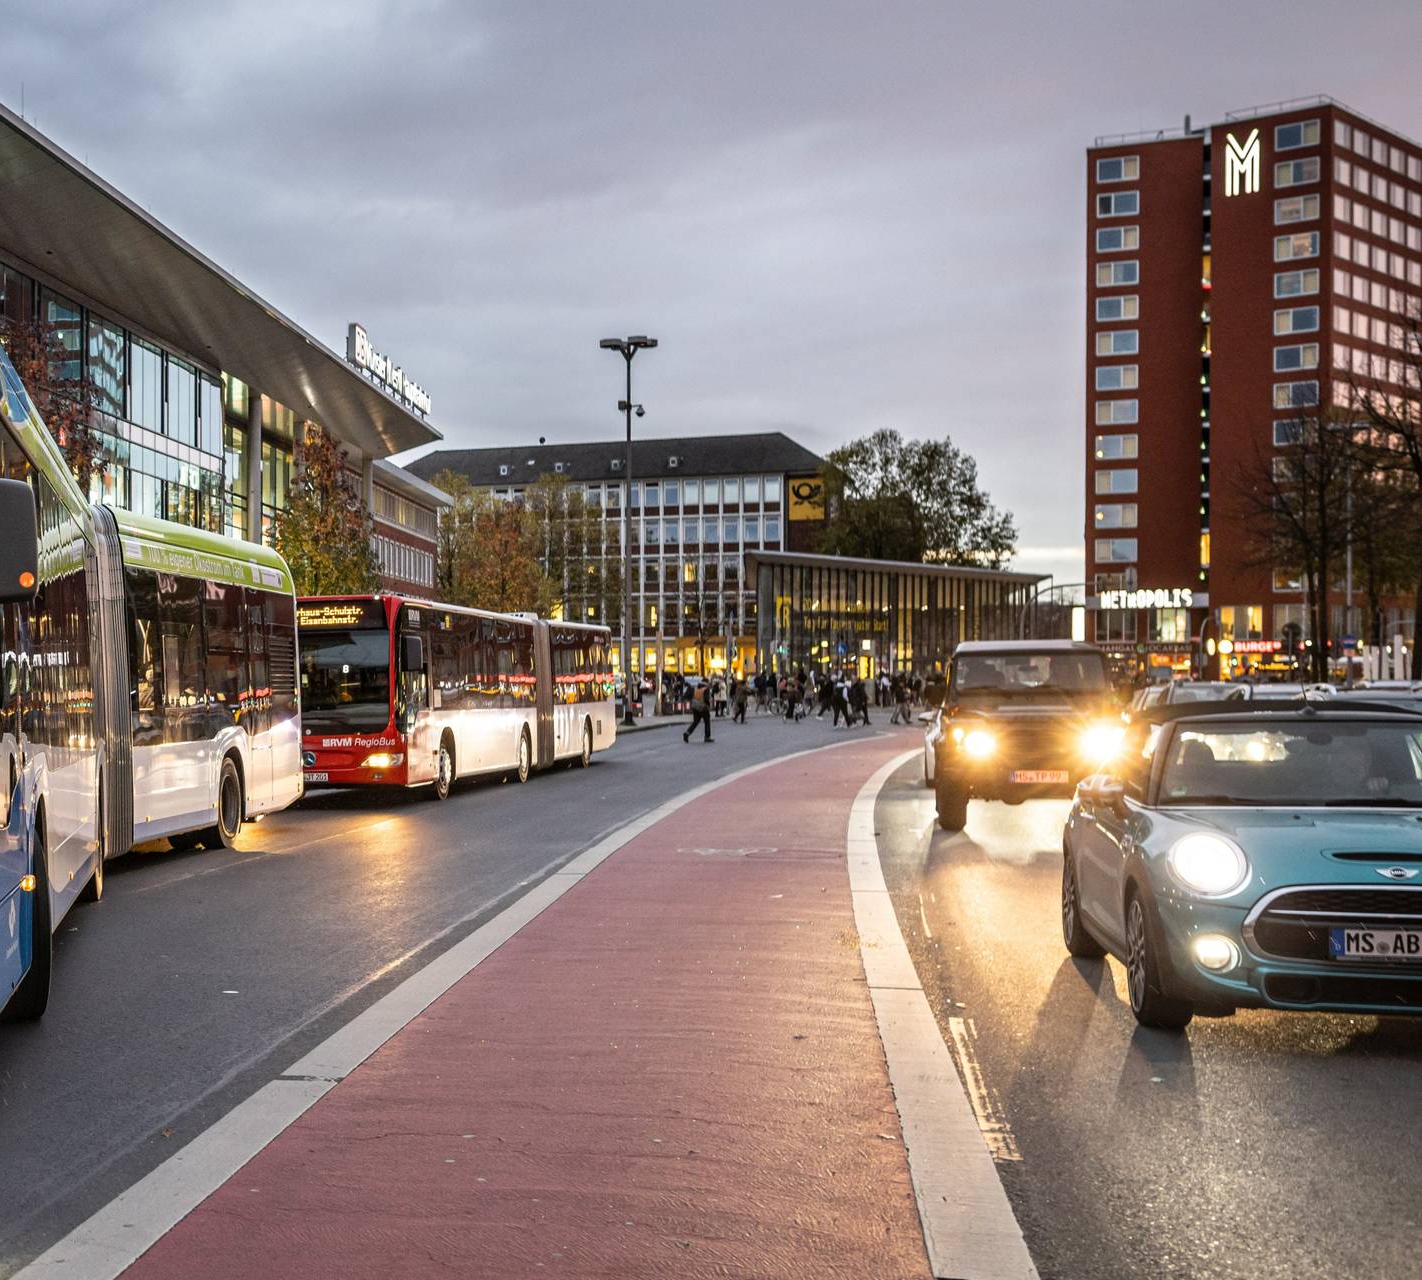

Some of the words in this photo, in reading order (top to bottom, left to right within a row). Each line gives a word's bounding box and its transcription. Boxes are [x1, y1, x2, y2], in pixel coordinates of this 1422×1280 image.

[331, 738, 352, 747] RVM
[354, 737, 396, 748] RegioBus
[1346, 932, 1374, 953] MS
[1393, 933, 1420, 954] AB
